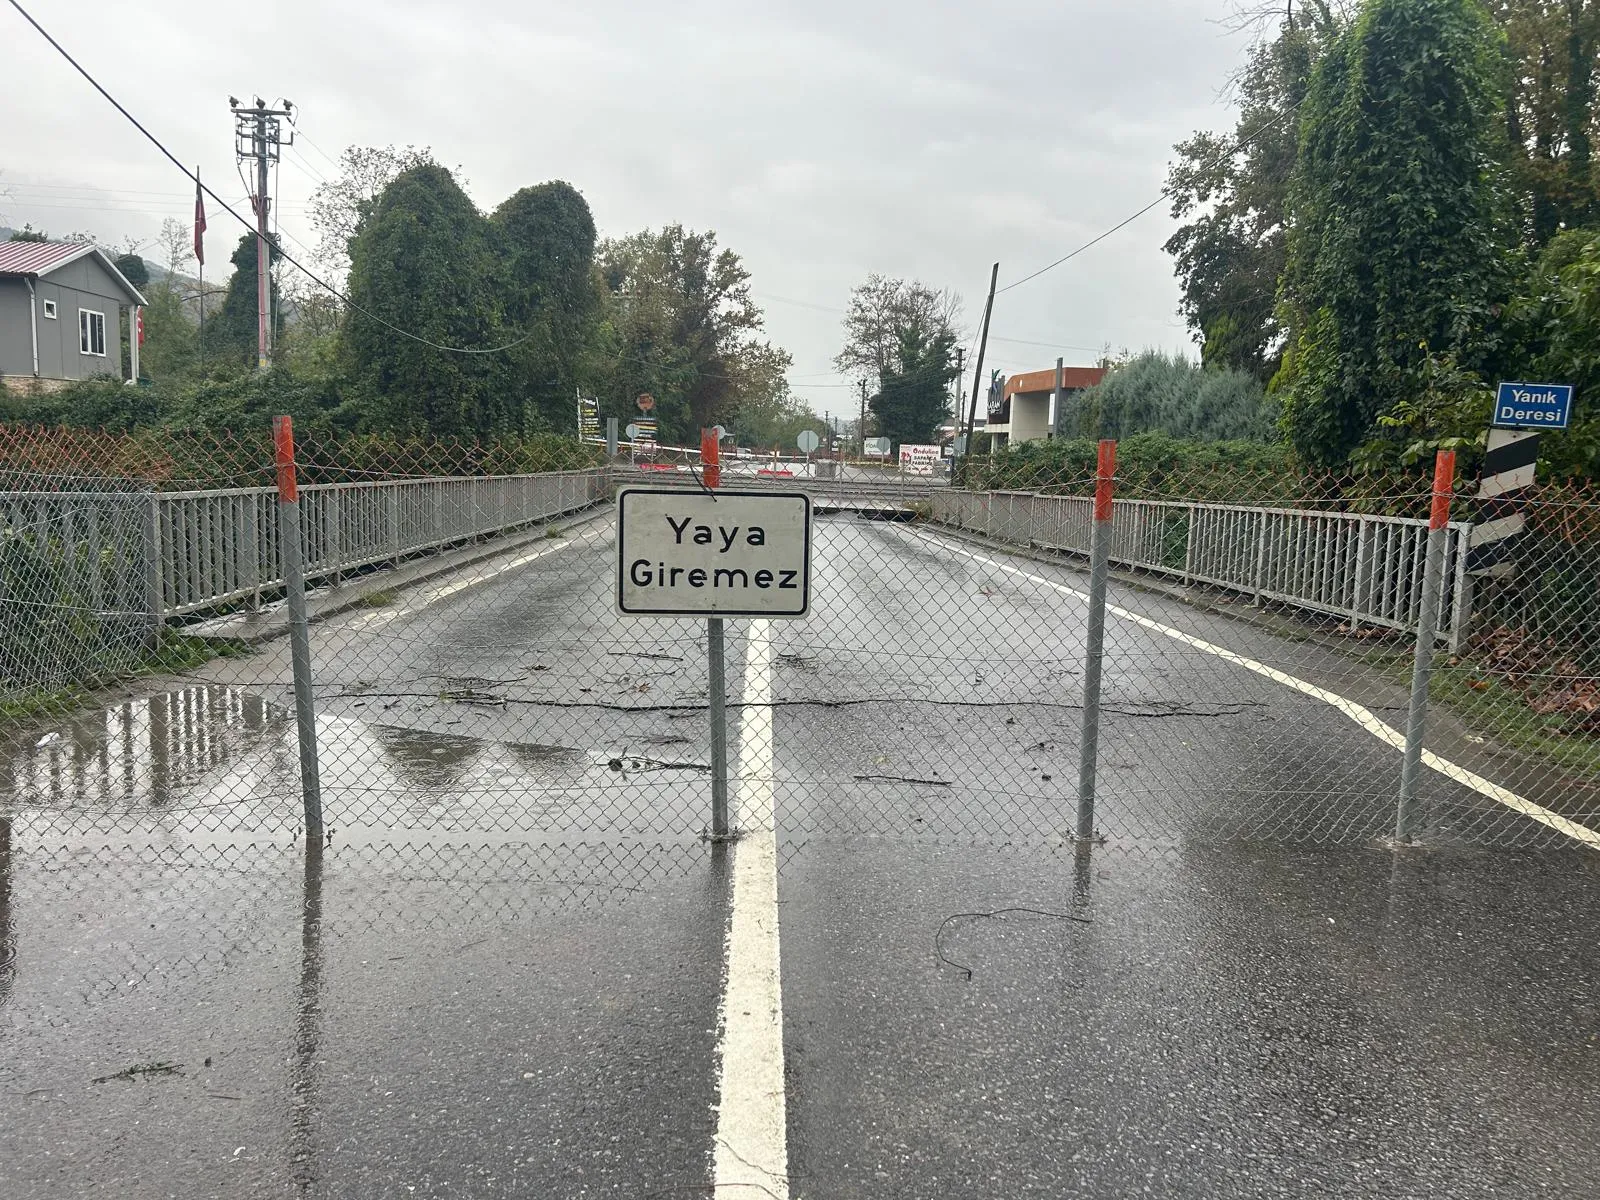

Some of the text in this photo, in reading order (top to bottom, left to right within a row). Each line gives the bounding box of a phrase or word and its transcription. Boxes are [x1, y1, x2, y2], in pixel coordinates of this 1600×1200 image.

[1512, 389, 1557, 404] Yanık
[1500, 406, 1562, 422] Deresi
[666, 517, 765, 553] Yaya
[630, 559, 798, 589] Giremez
